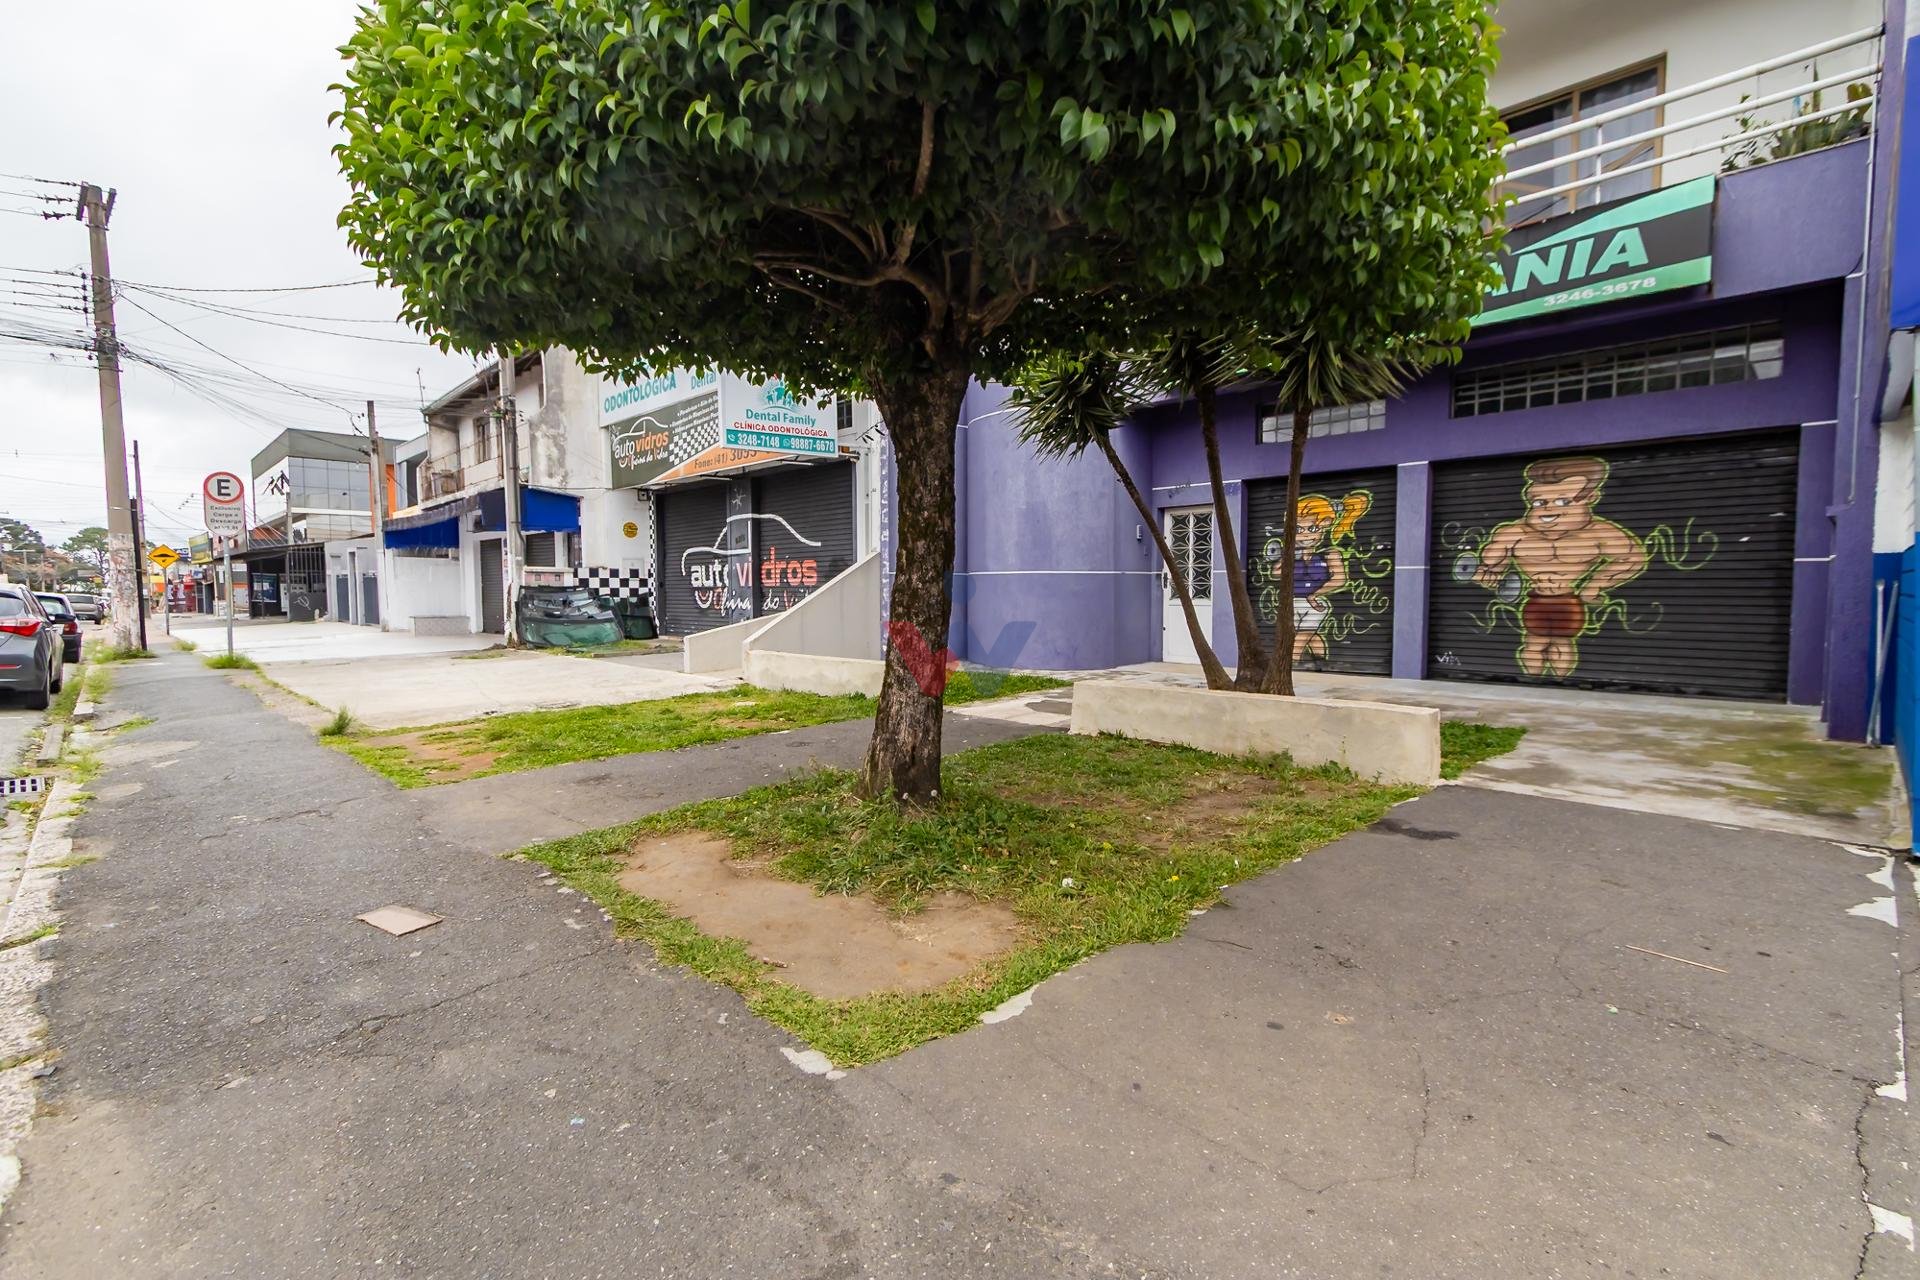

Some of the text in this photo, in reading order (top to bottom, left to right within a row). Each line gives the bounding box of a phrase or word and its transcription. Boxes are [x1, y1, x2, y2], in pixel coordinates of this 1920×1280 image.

[1543, 277, 1656, 306] 3246-3678
[745, 408, 817, 427] Dental Family
[733, 421, 767, 432] CLÍNICA
[767, 424, 829, 438] ODONTOLÓGICA
[737, 433, 780, 448] 3248-7148
[216, 478, 231, 497] E
